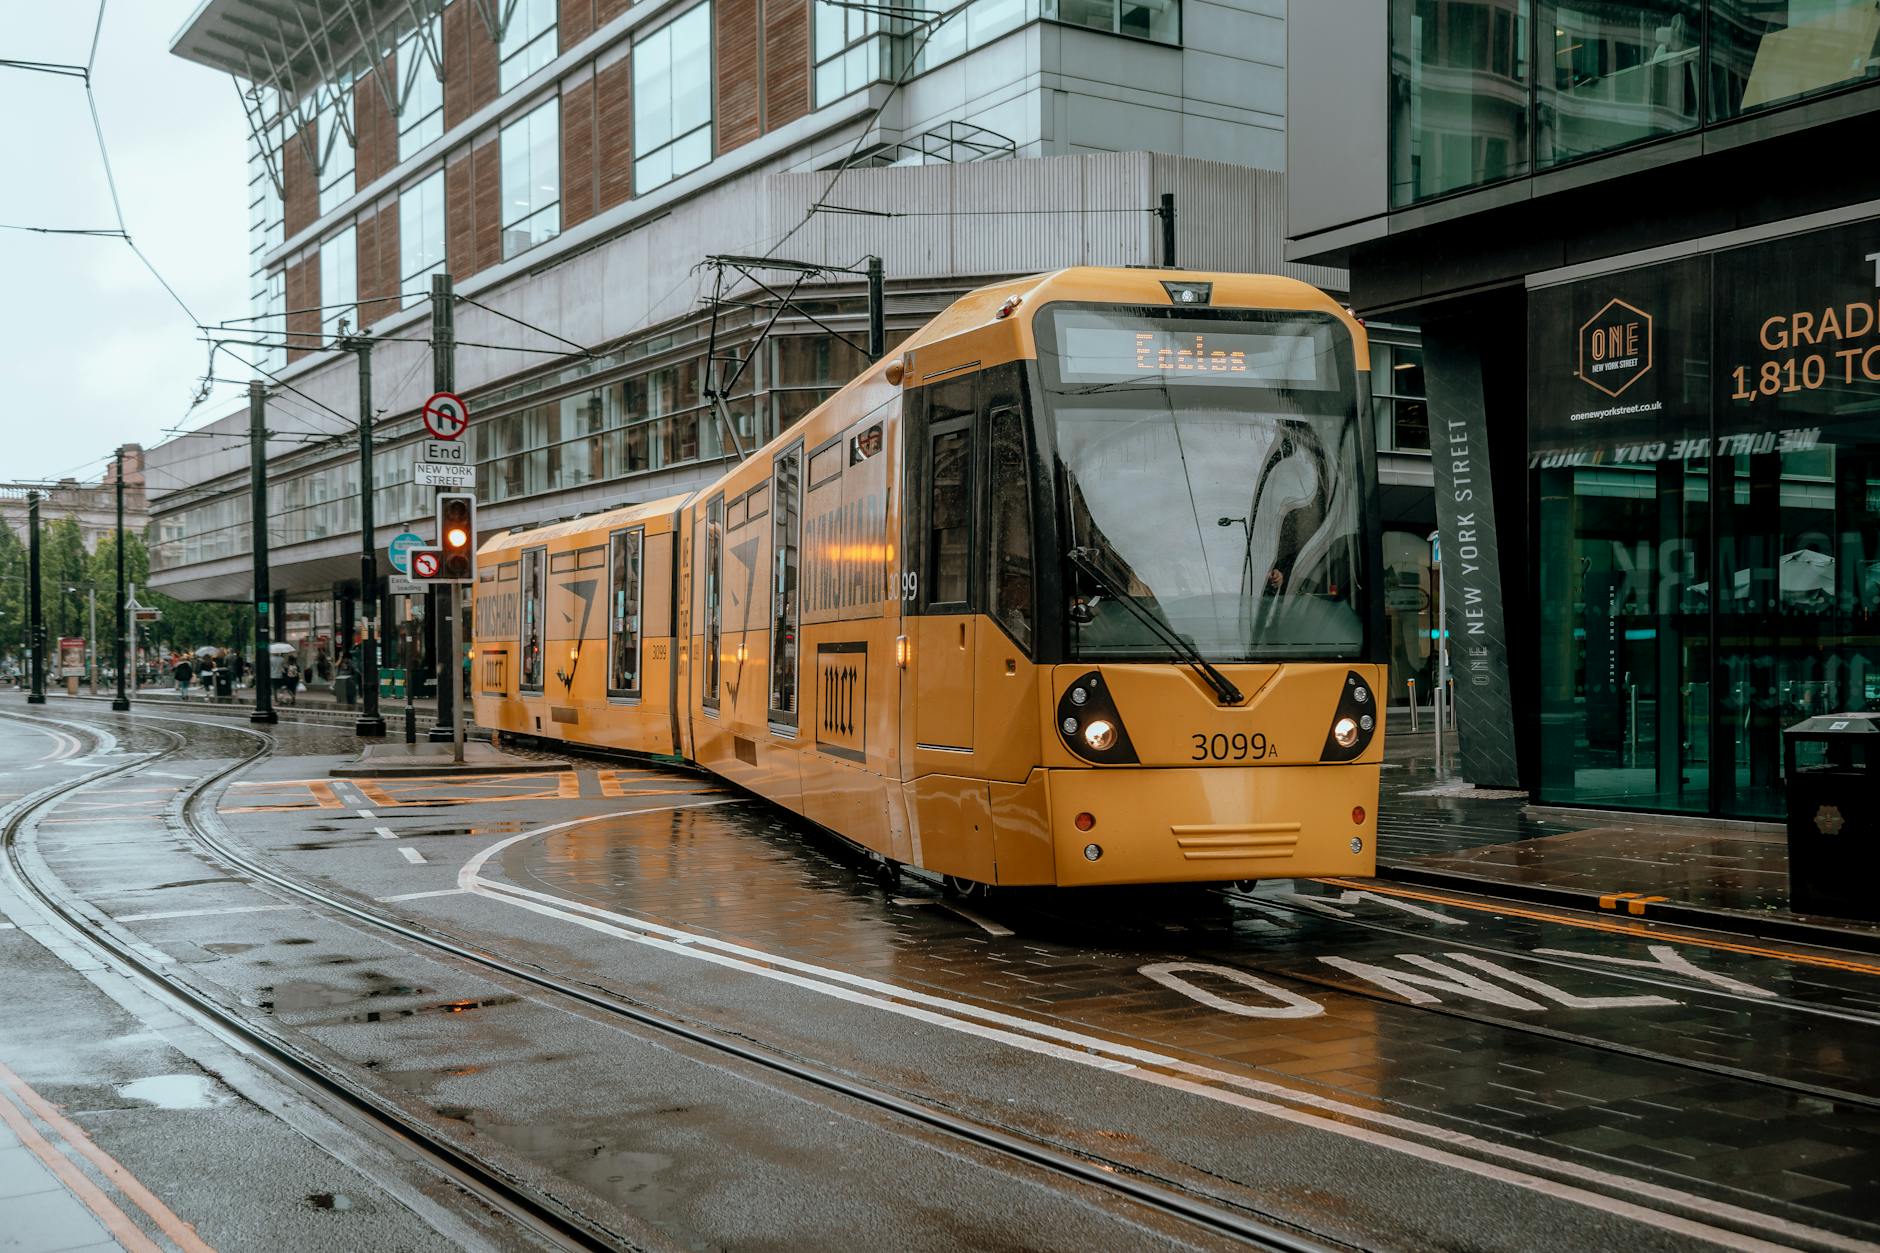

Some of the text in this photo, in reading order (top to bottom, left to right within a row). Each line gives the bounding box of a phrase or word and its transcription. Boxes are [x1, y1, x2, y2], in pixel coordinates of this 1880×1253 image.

[1760, 299, 1880, 351] GRAD
[1136, 333, 1247, 371] Eccles
[1592, 322, 1640, 361] ONE
[1592, 358, 1639, 373] NEW YORK STREET
[1731, 354, 1826, 402] 1,810
[1570, 401, 1663, 421] onenewyorkstreet.co.uk
[429, 444, 461, 459] End
[417, 464, 473, 476] NEW YORK
[425, 476, 464, 486] STREET
[1448, 419, 1490, 686] ONE NEW YORK STREET
[888, 571, 918, 601] 3099
[652, 644, 667, 661] 3099
[1136, 945, 1778, 1019] ONLY
